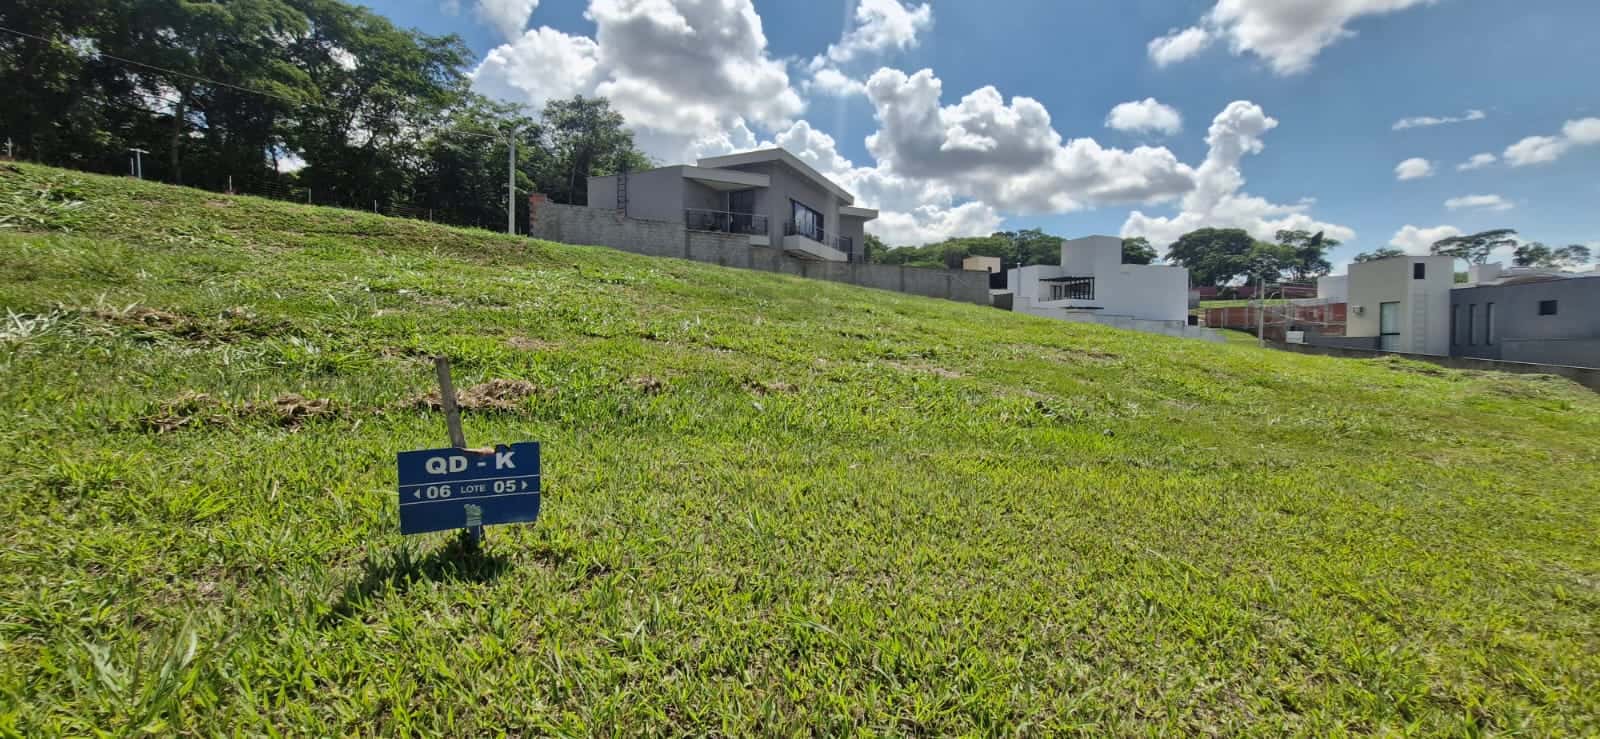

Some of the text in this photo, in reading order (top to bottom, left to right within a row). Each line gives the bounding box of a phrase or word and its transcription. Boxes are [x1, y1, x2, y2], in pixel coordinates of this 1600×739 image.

[425, 456, 468, 475] QD
[495, 451, 515, 469] K
[426, 480, 517, 499] 06 LOTE 05
